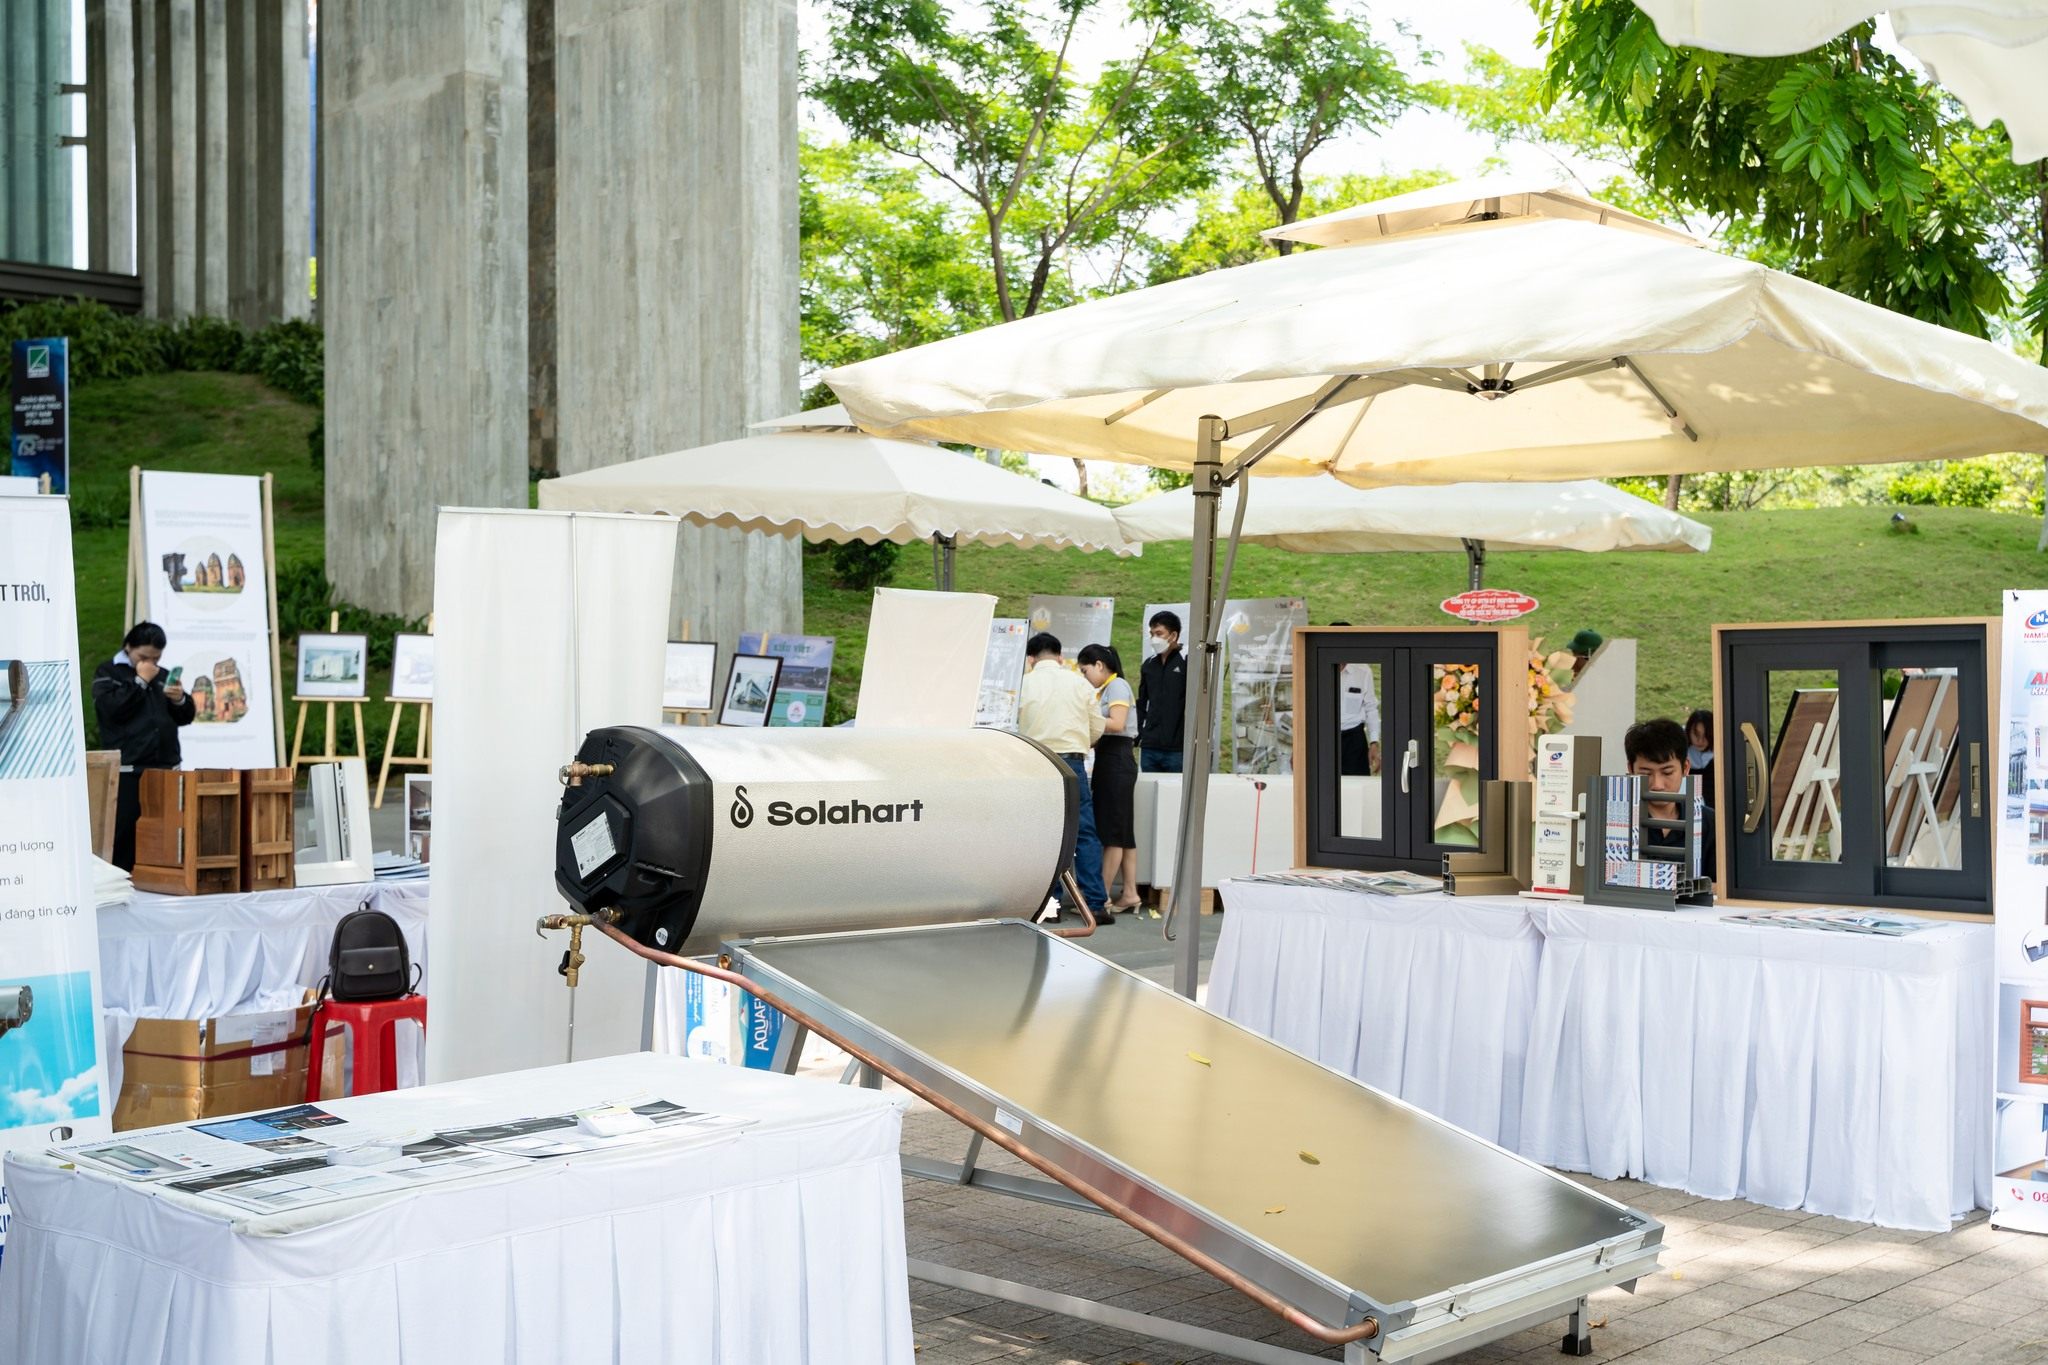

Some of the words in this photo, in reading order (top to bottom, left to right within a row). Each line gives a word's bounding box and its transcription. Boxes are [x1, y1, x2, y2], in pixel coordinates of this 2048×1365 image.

[11, 580, 50, 604] TRỜI,
[767, 799, 923, 827] Solahart
[38, 906, 53, 917] tin
